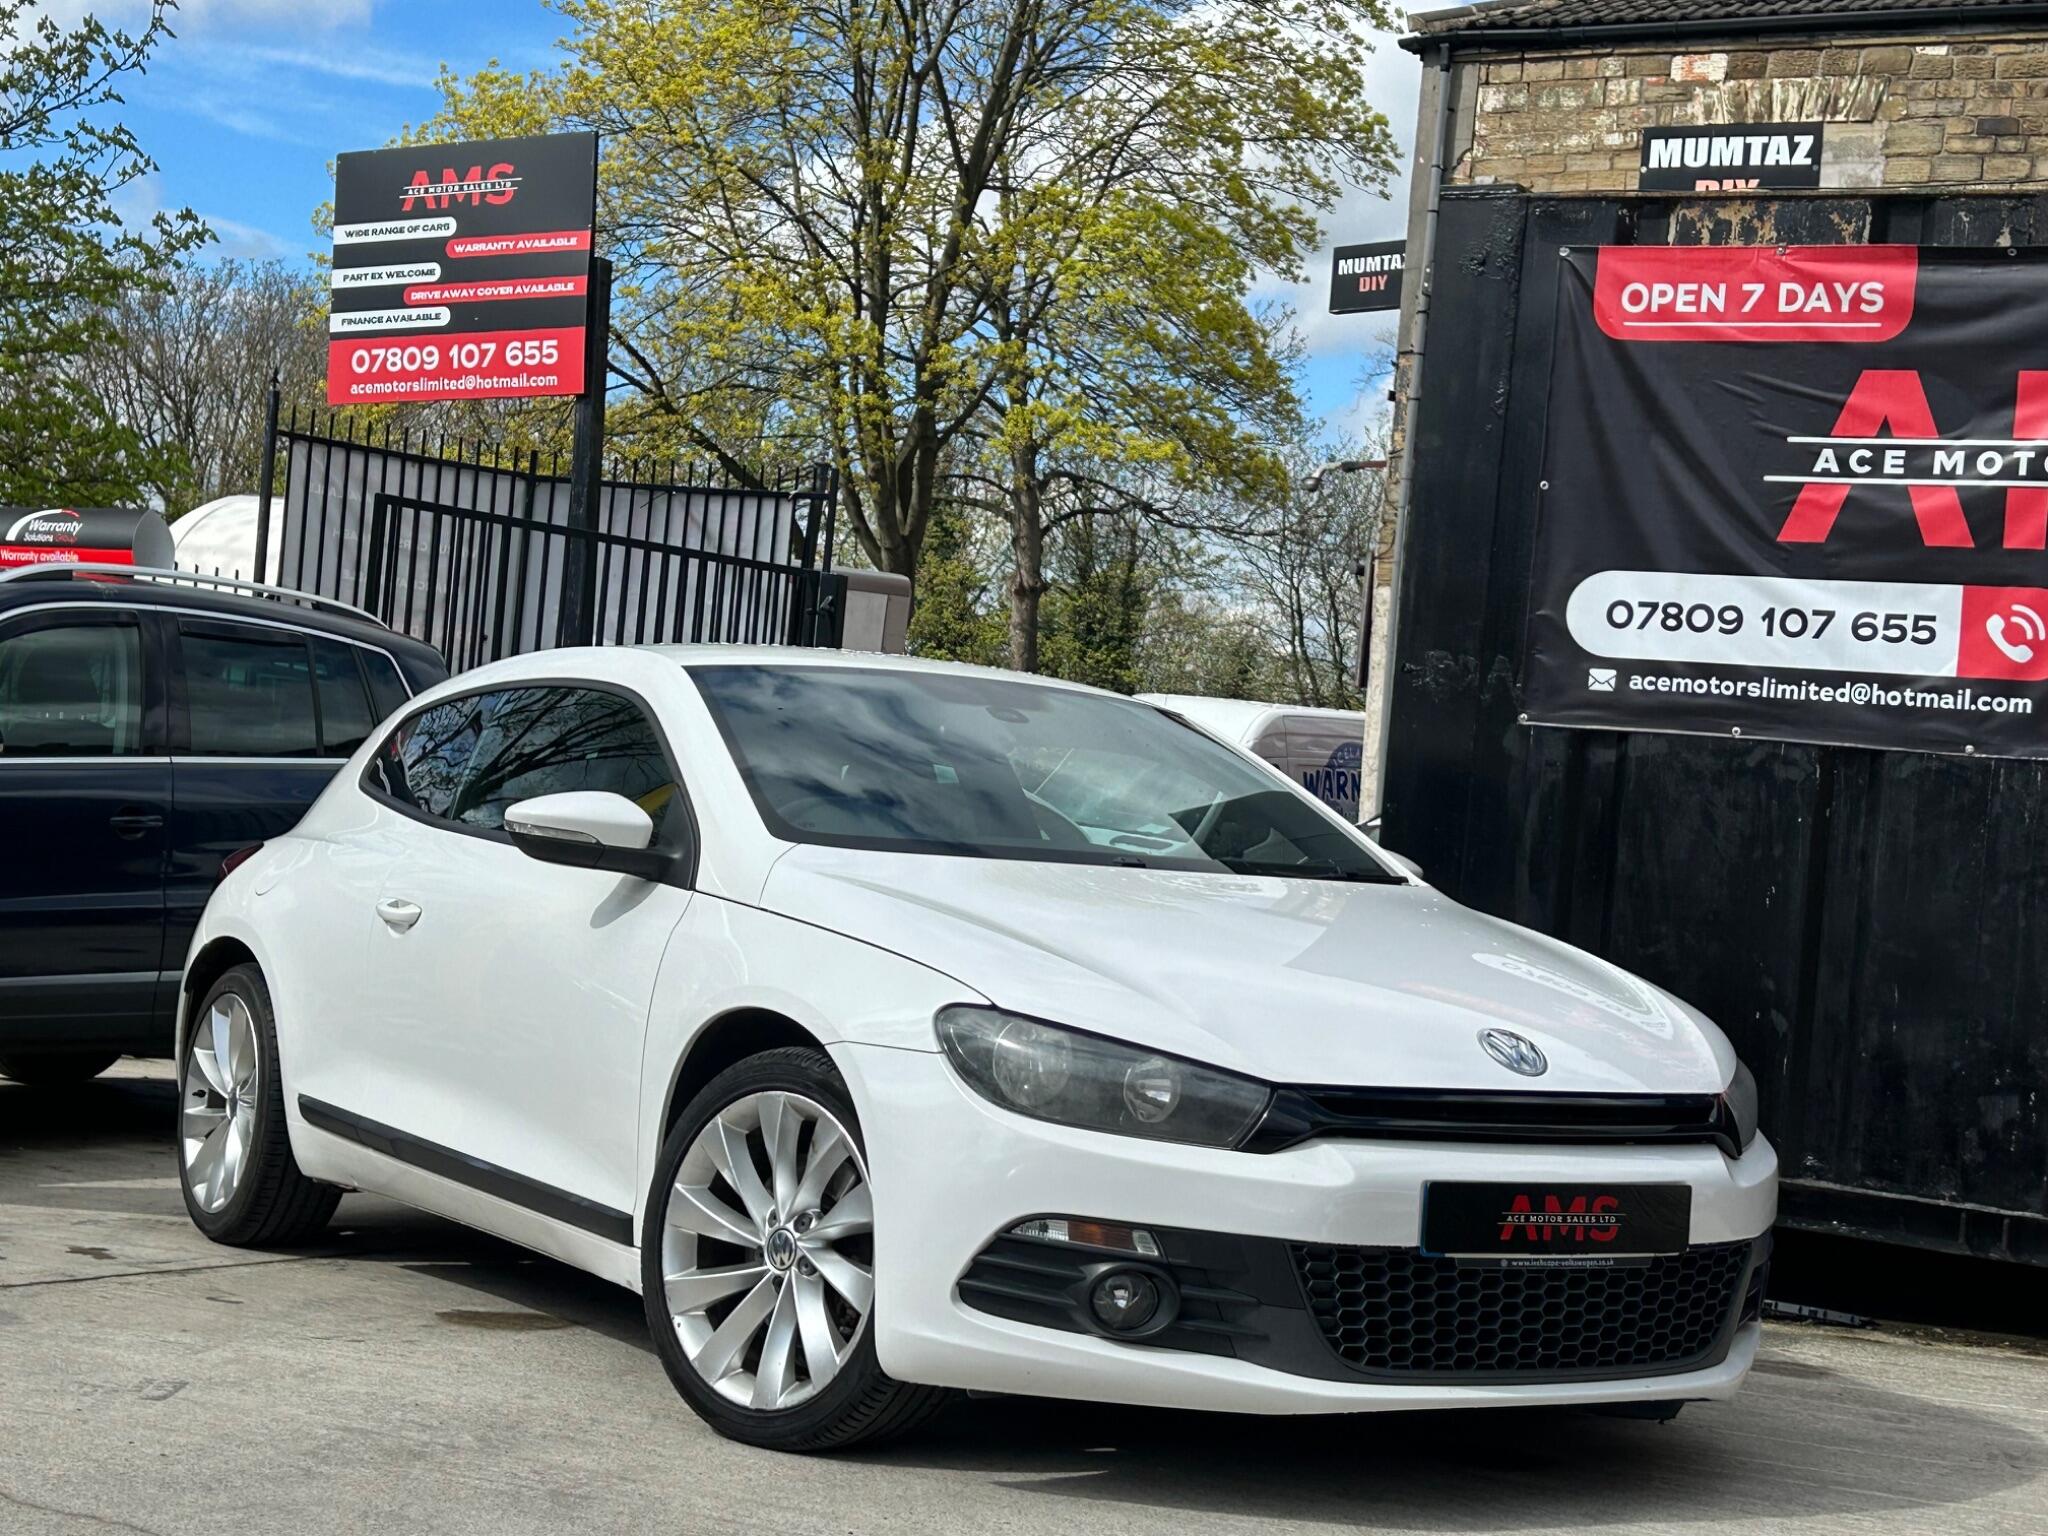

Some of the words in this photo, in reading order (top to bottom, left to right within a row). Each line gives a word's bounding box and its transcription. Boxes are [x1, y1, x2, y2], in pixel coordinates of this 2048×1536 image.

[1648, 135, 1815, 169] MUMTAZ
[401, 162, 515, 211] AMS
[428, 184, 459, 193] MOTOR
[463, 181, 491, 191] SALES
[495, 180, 512, 189] LTD
[344, 227, 370, 238] WIDE
[371, 225, 405, 236] RANGE
[408, 224, 420, 234] OF
[422, 223, 450, 233] CARS
[454, 240, 515, 253] WARRANTY
[516, 237, 577, 249] AVAILABLE
[343, 272, 369, 282] PART
[371, 271, 383, 281] EX
[385, 268, 436, 280] WELCOME
[1359, 274, 1388, 292] DIY
[411, 290, 441, 300] DRIVE
[441, 288, 476, 299] AWAY
[477, 285, 513, 297] COVER
[514, 282, 575, 294] AVAILABLE
[1621, 282, 1727, 313] OPEN
[1741, 283, 1766, 313] 7
[1778, 281, 1885, 313] DAYS
[341, 316, 384, 326] FINANCE
[385, 313, 441, 324] AVAILABLE
[351, 345, 439, 374] 07809
[449, 342, 496, 369] 107
[505, 339, 559, 367] 655
[350, 373, 558, 395] acemotorslimited@hotmail.com
[1776, 369, 2048, 550] A
[1812, 448, 1906, 476] ACE
[1932, 449, 2048, 477] MOT
[23, 532, 54, 542] Solutions
[29, 520, 83, 536] Warranty
[0, 549, 39, 563] Warranty
[40, 551, 79, 562] available
[1606, 599, 1744, 635] 07809
[1761, 607, 1836, 640] 107
[1851, 611, 1937, 645] 655
[1629, 674, 2033, 714] acemotorslimited@hotmail.com
[1500, 1194, 1619, 1241] AMS
[1506, 1215, 1525, 1223] ACE
[1529, 1215, 1563, 1223] MOTOR
[1566, 1215, 1596, 1223] SALES
[1599, 1215, 1617, 1223] LTD
